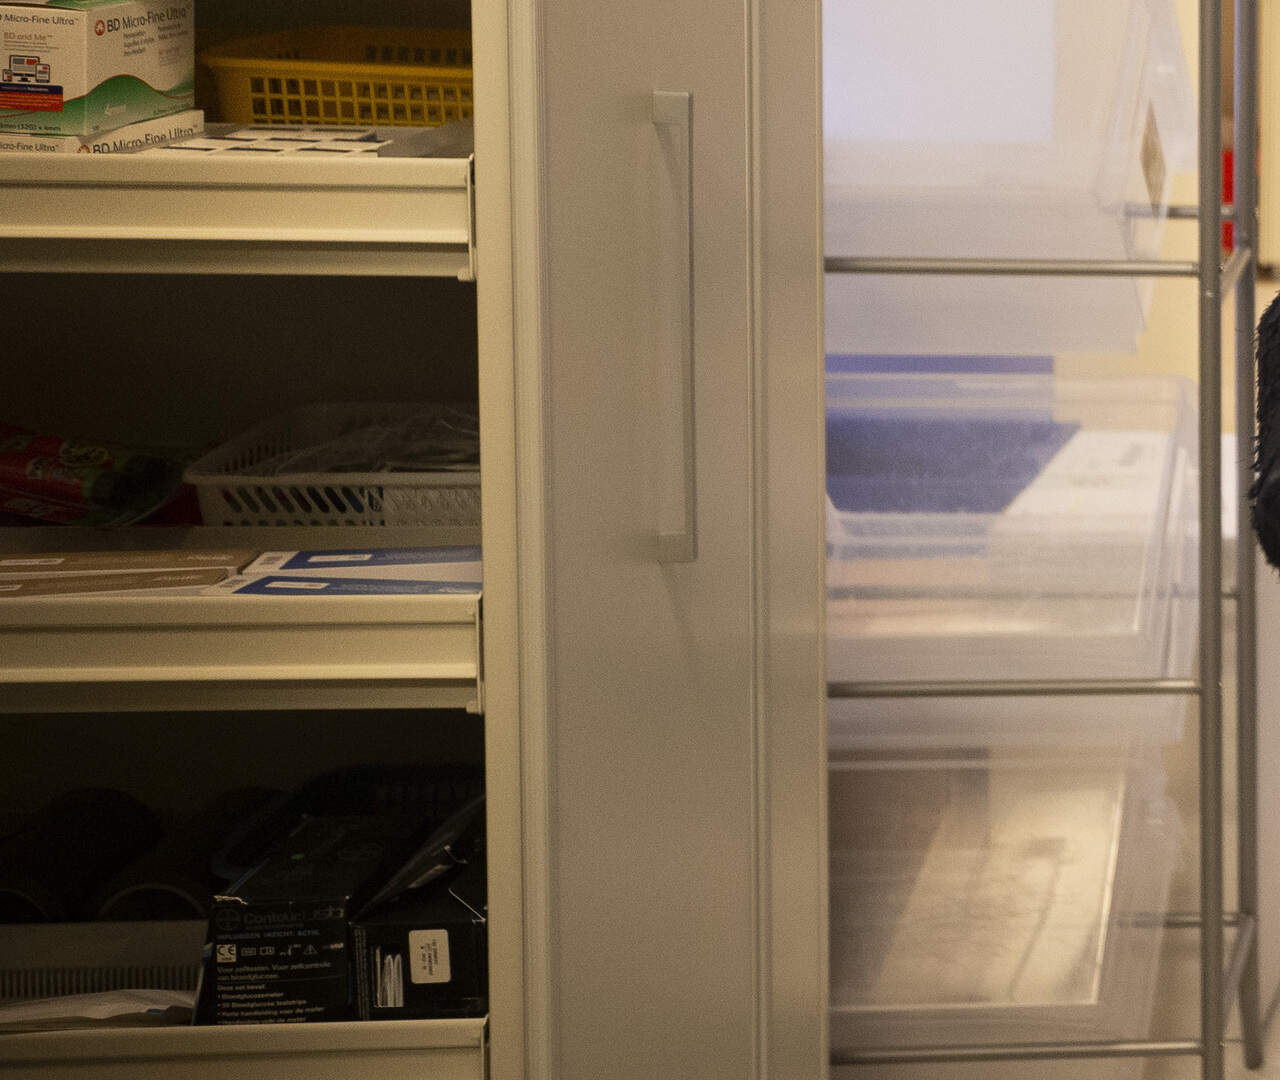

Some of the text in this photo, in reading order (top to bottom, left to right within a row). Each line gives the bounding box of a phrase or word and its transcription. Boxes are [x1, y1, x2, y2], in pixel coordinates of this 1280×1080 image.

[52, 15, 75, 25] Ultra
[107, 7, 188, 32] BD Micro-Fine Ultra
[169, 126, 193, 139] Ultra
[0, 142, 56, 151] cro-Fine Ultra
